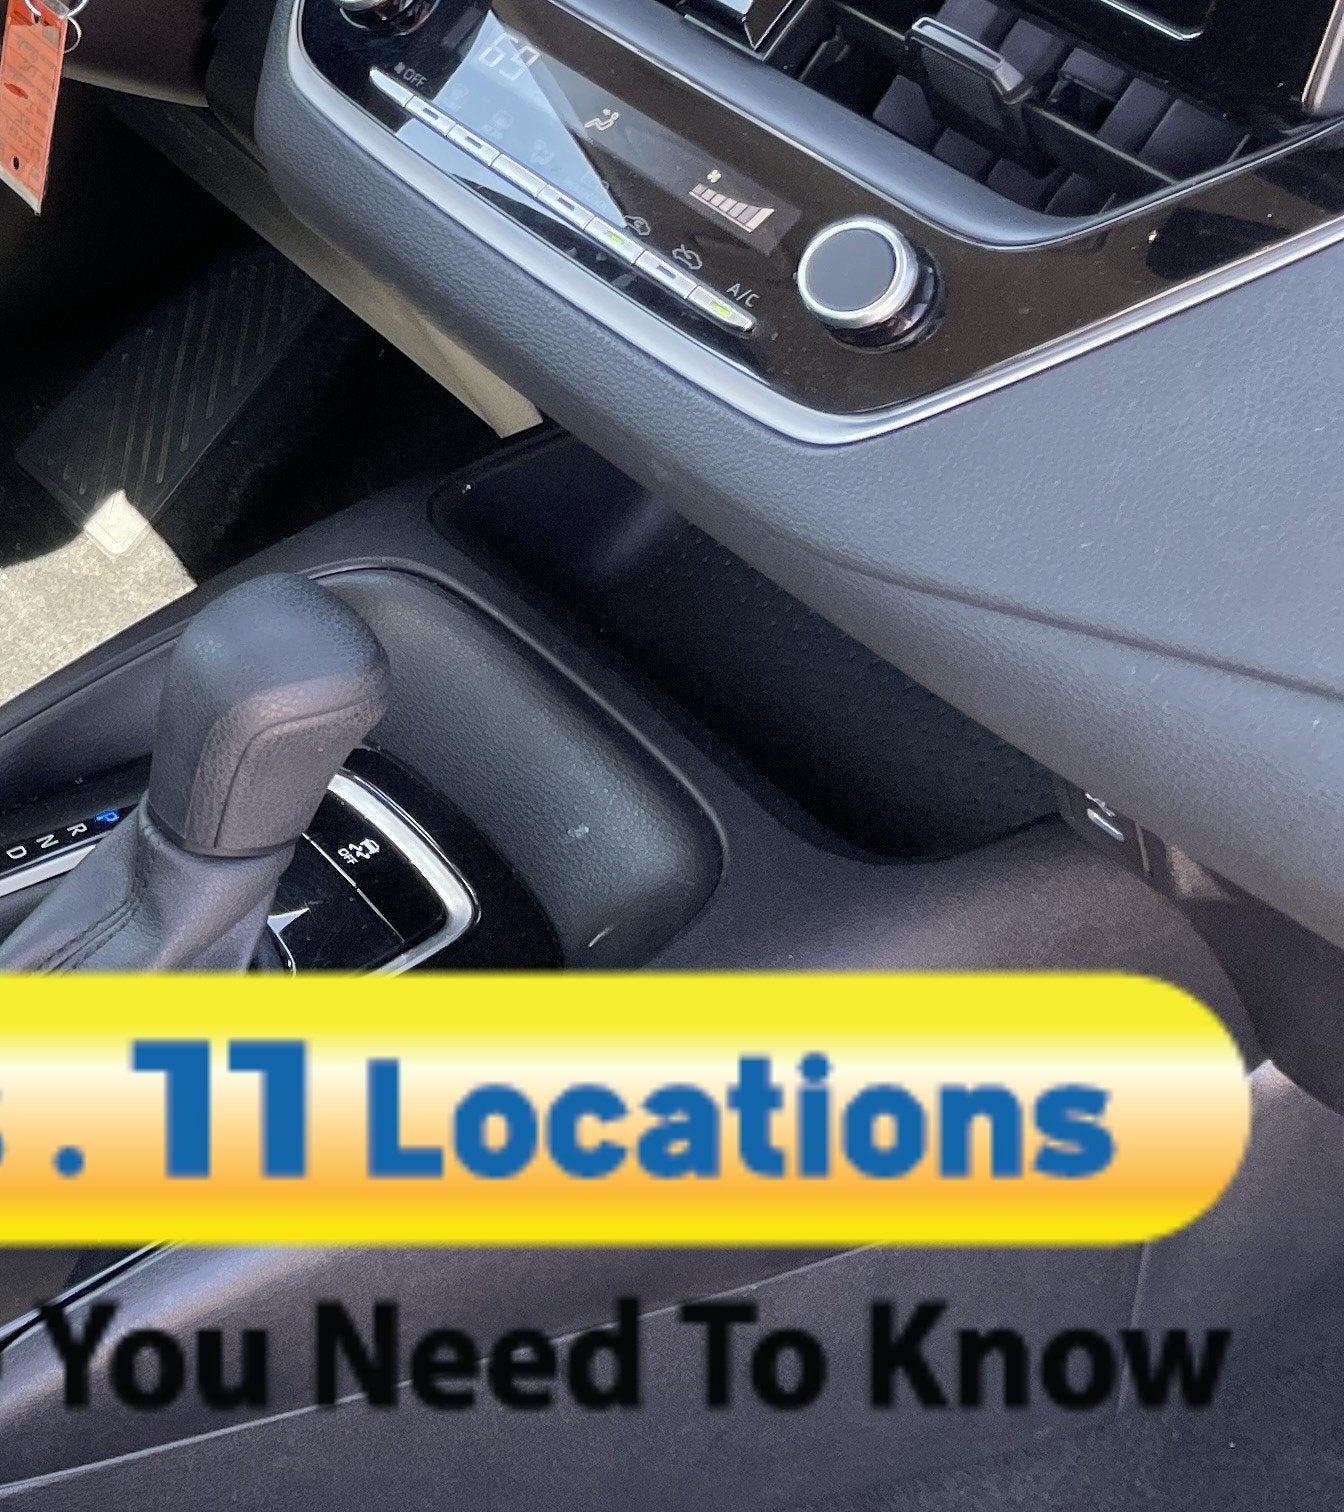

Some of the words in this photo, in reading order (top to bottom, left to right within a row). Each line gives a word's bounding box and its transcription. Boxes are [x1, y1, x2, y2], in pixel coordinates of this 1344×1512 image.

[403, 70, 428, 88] OFF
[726, 283, 760, 308] A/C
[95, 809, 119, 823] P
[67, 822, 88, 837] R
[36, 834, 60, 849] N
[6, 845, 27, 860] D
[337, 847, 358, 865] OFF
